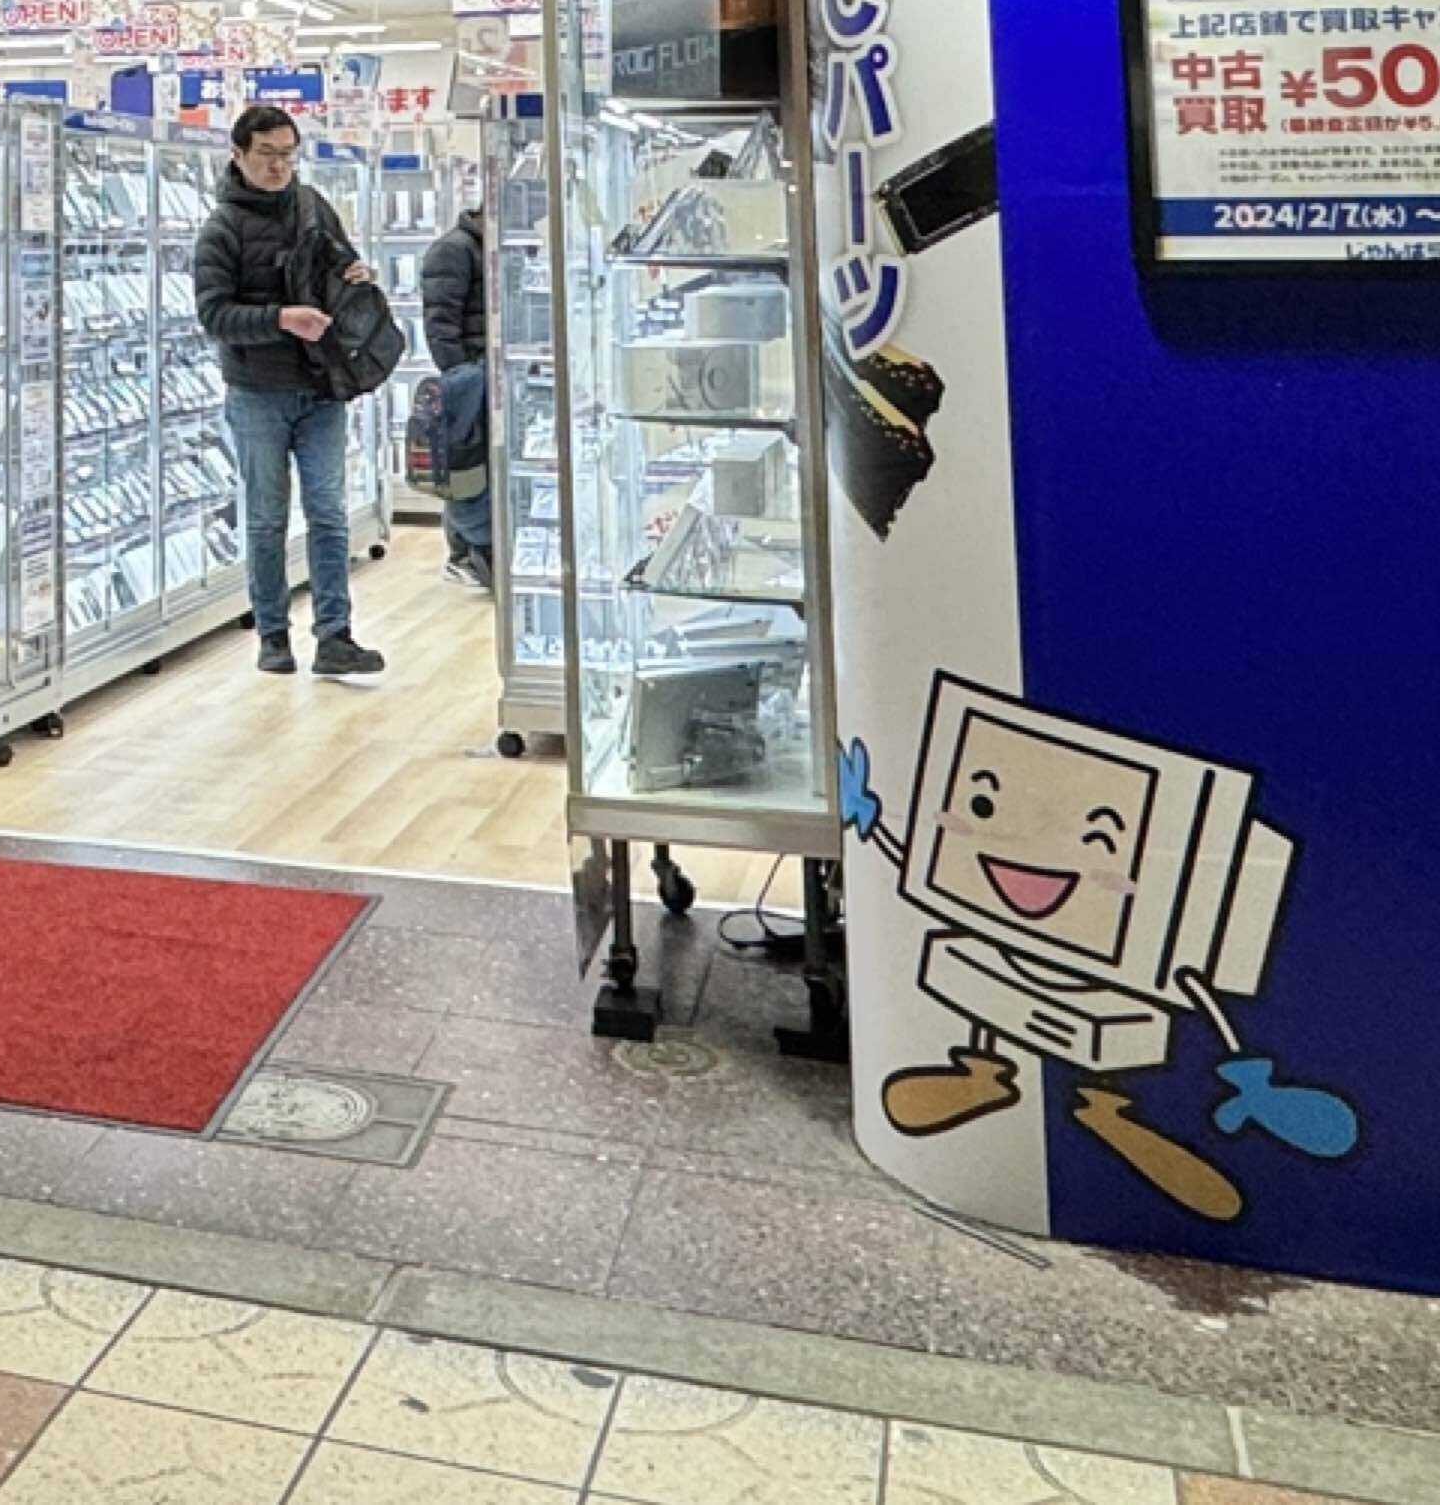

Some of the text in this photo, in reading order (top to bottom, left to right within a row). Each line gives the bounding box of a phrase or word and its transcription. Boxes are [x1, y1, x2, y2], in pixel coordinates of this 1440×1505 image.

[1171, 50, 1263, 91] 中古
[1173, 96, 1268, 135] 買取
[1214, 200, 1408, 229] 2024/2/7(水)
